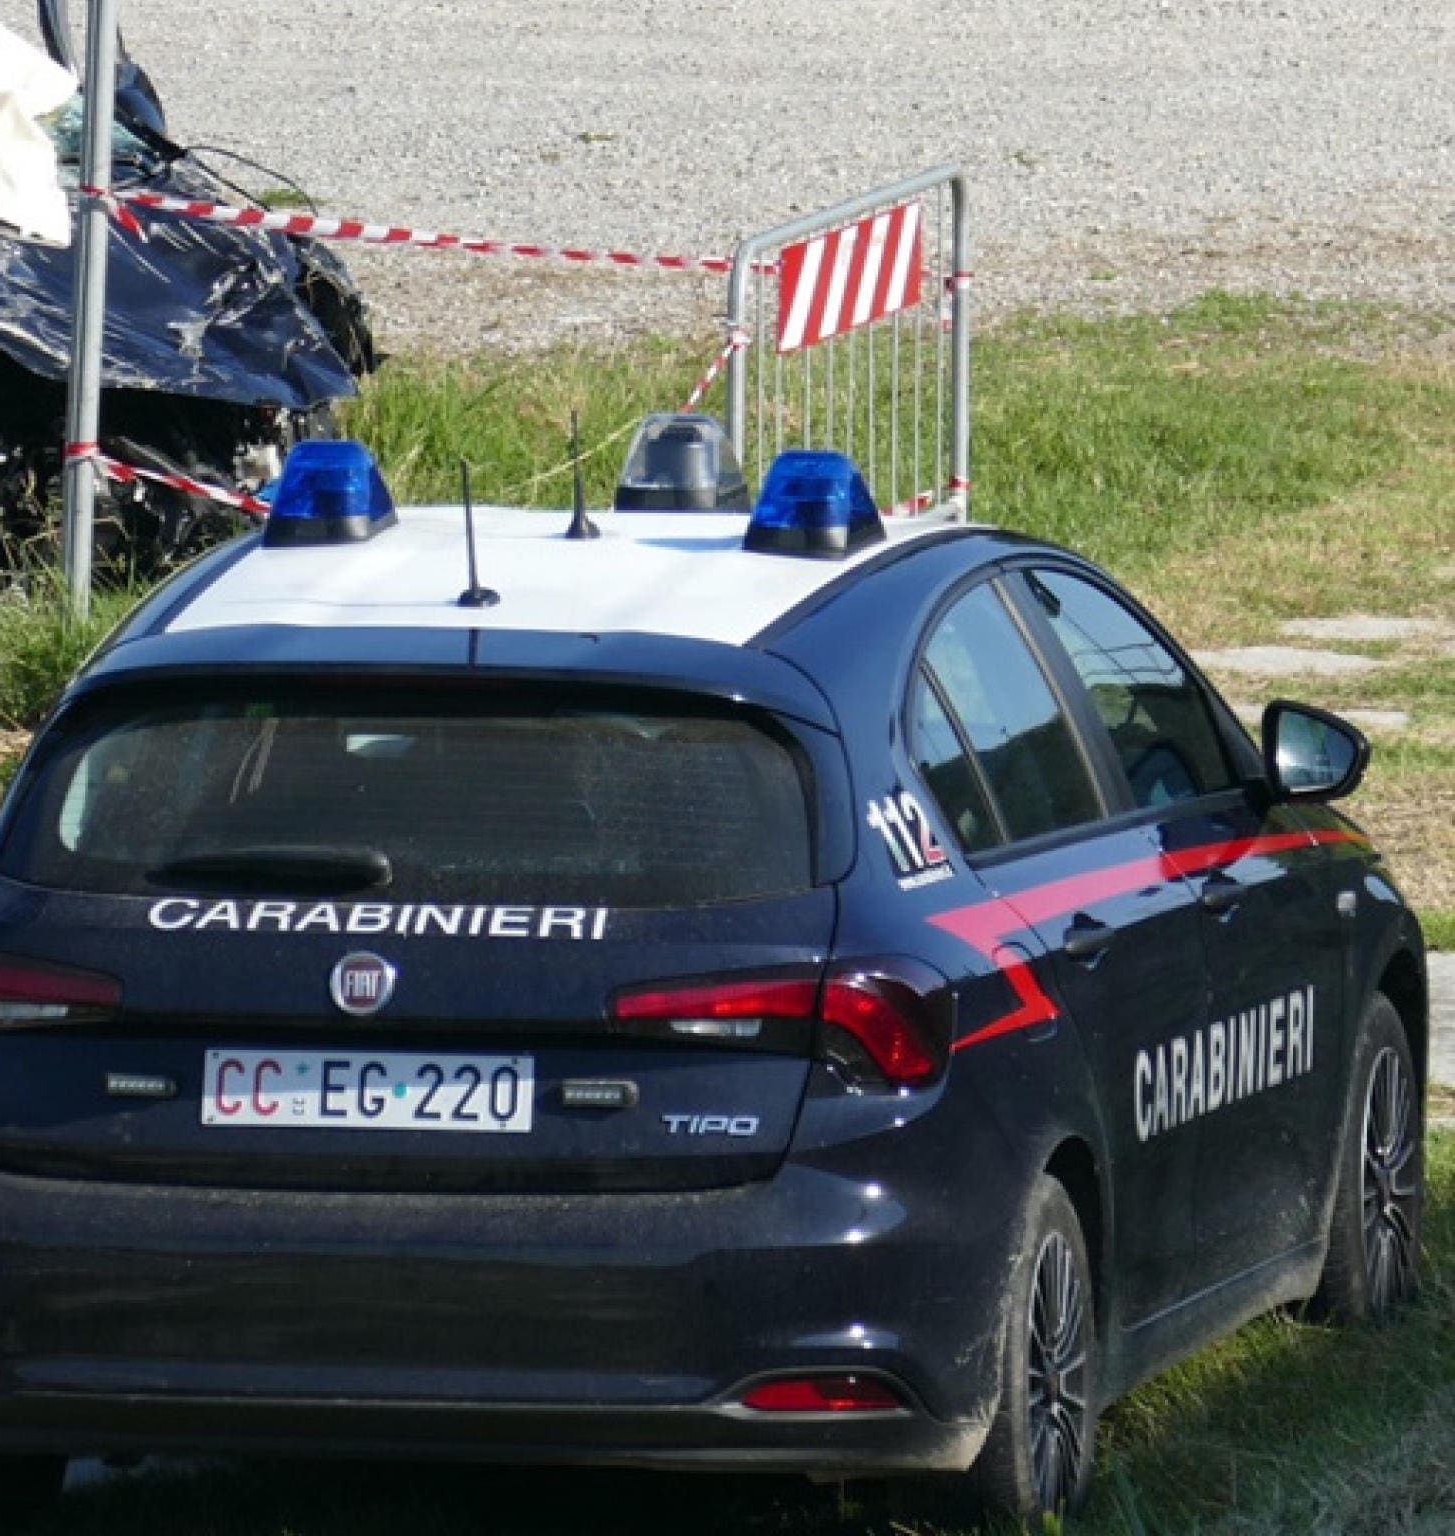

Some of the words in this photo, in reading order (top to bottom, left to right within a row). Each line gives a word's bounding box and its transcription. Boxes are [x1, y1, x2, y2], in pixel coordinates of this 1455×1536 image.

[866, 791, 949, 872] 112
[147, 898, 609, 940] CARABINIERI
[345, 970, 382, 999] FIAT
[1134, 983, 1315, 1143] CARABINIERI
[215, 1059, 282, 1116] CC
[320, 1060, 387, 1118] EG
[412, 1063, 519, 1122] 220
[661, 1114, 759, 1137] TIPO
